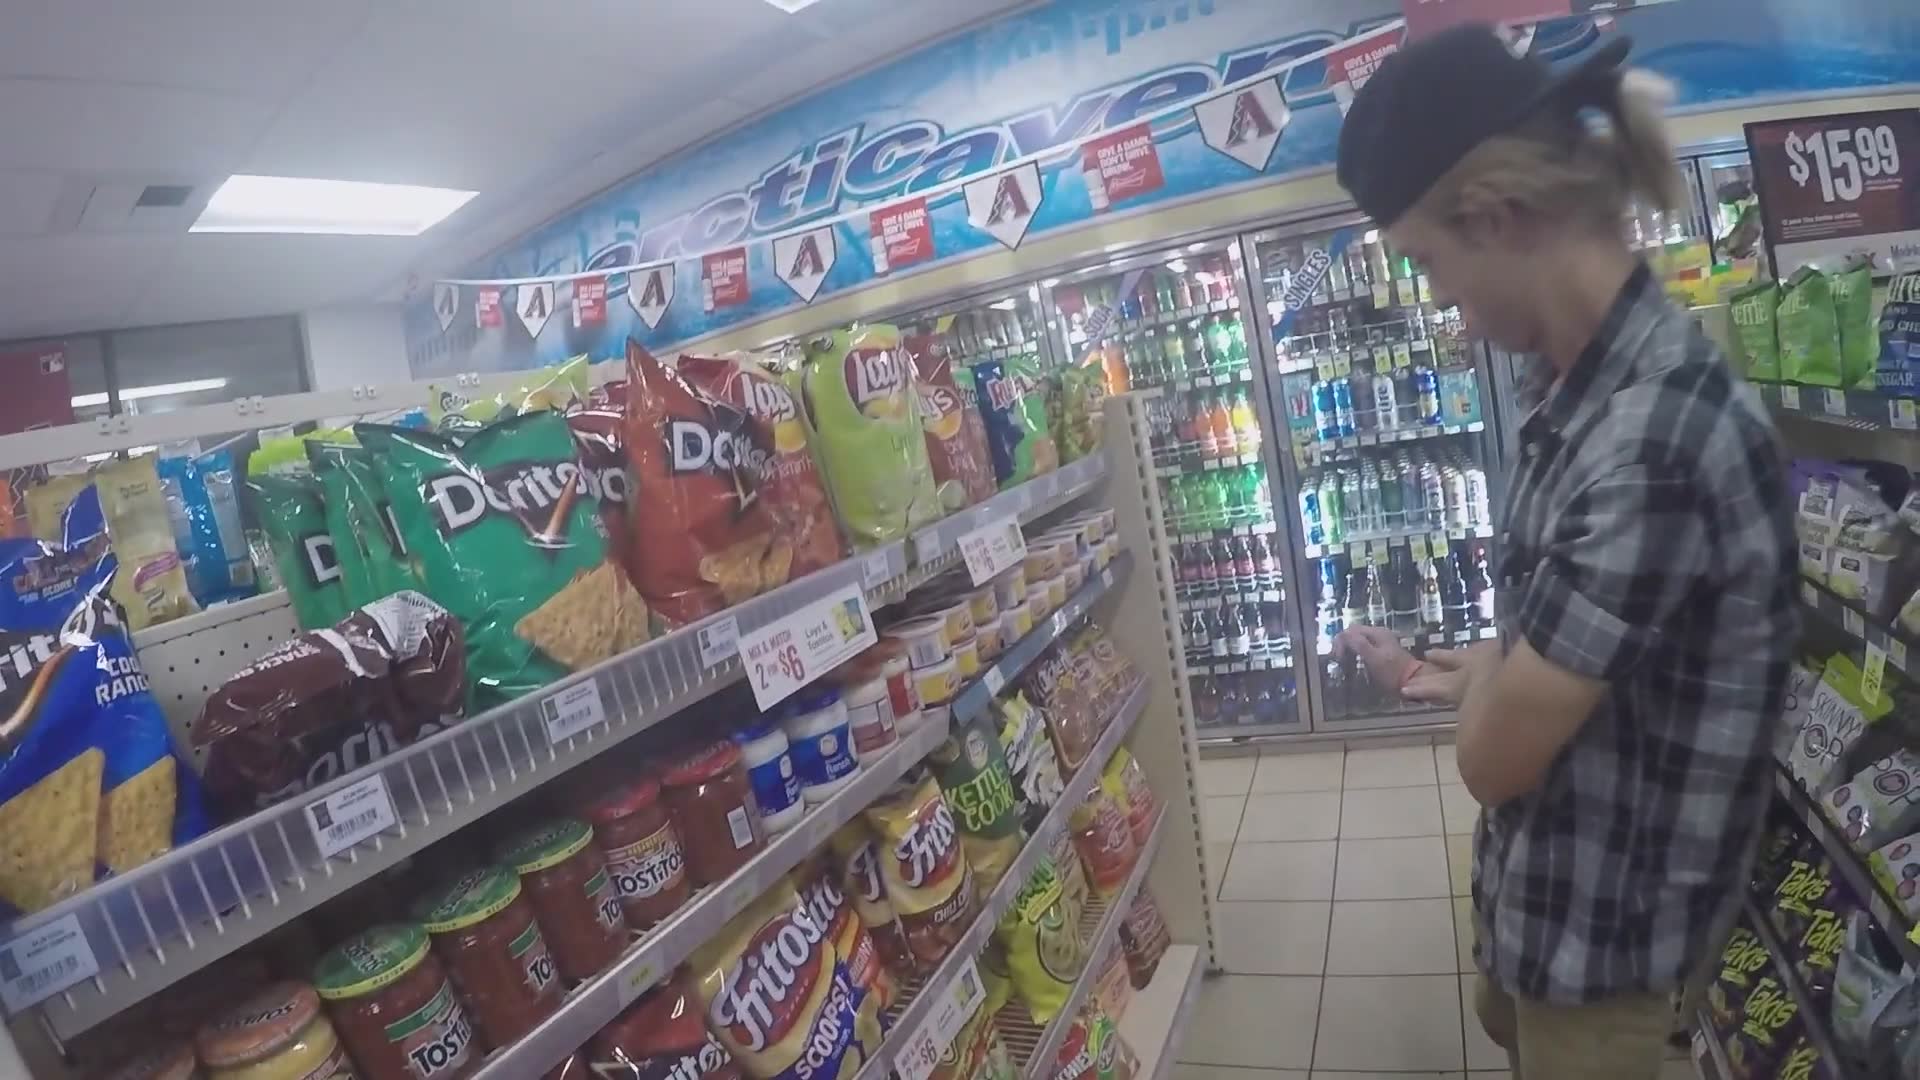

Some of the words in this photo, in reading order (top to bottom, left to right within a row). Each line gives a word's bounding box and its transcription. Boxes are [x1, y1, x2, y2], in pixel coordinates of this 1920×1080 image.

[1283, 248, 1332, 309] SINGLES
[755, 663, 769, 691] 2
[778, 644, 806, 682] $6
